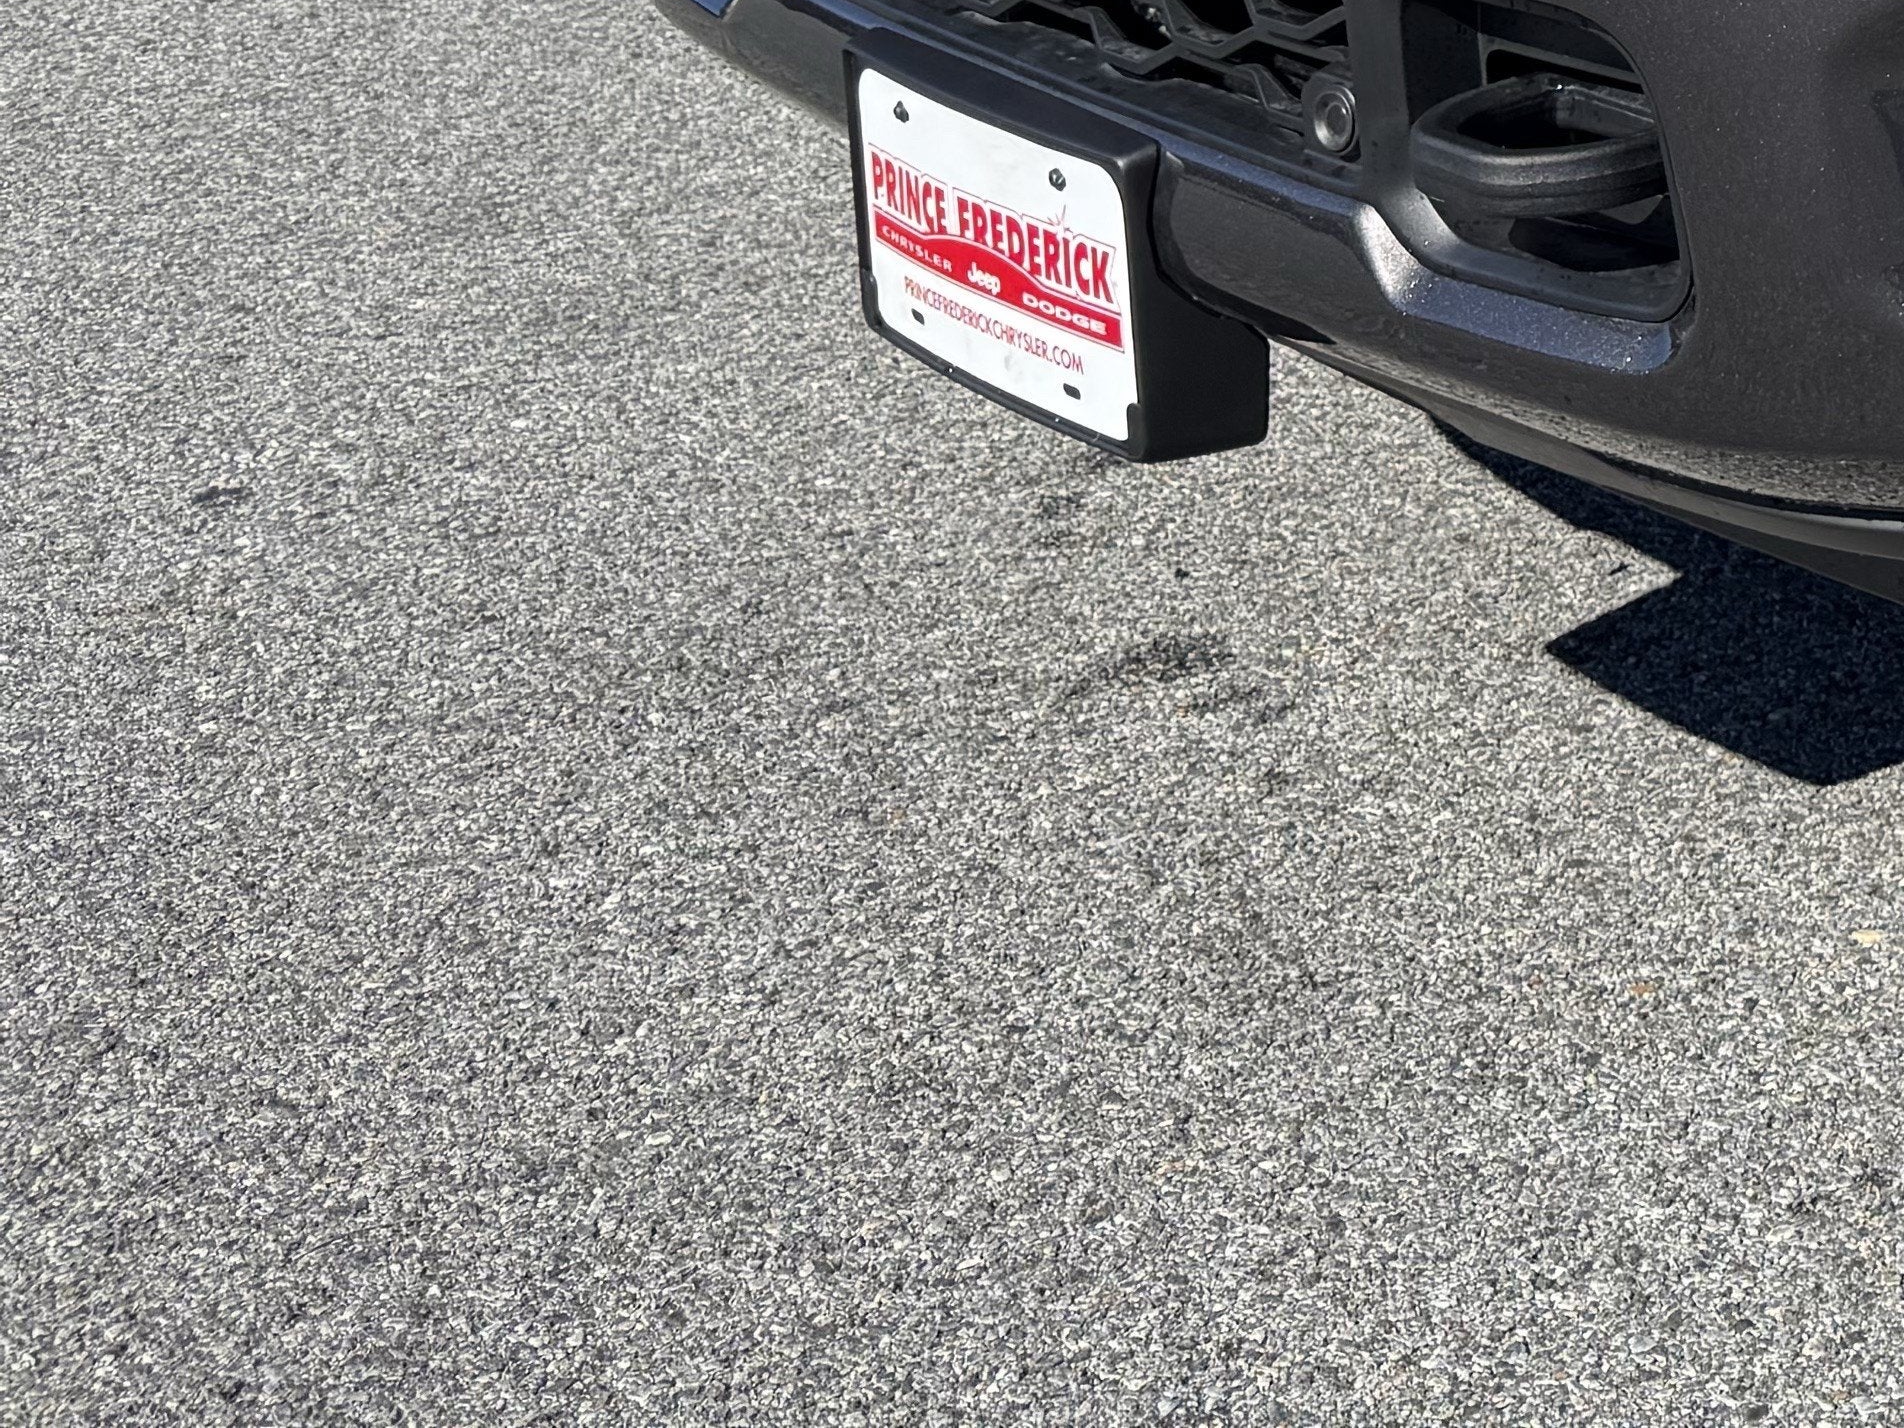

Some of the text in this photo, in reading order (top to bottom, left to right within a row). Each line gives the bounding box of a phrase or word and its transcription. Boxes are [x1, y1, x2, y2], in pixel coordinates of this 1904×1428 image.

[869, 148, 1114, 305] PRINCE FREDERICK
[881, 224, 954, 274] CHRYSLER
[966, 261, 1001, 296] Jeep
[902, 274, 1085, 376] PRINCEFREDERICKCHRYSLER.COM
[1021, 290, 1109, 338] DODGE
